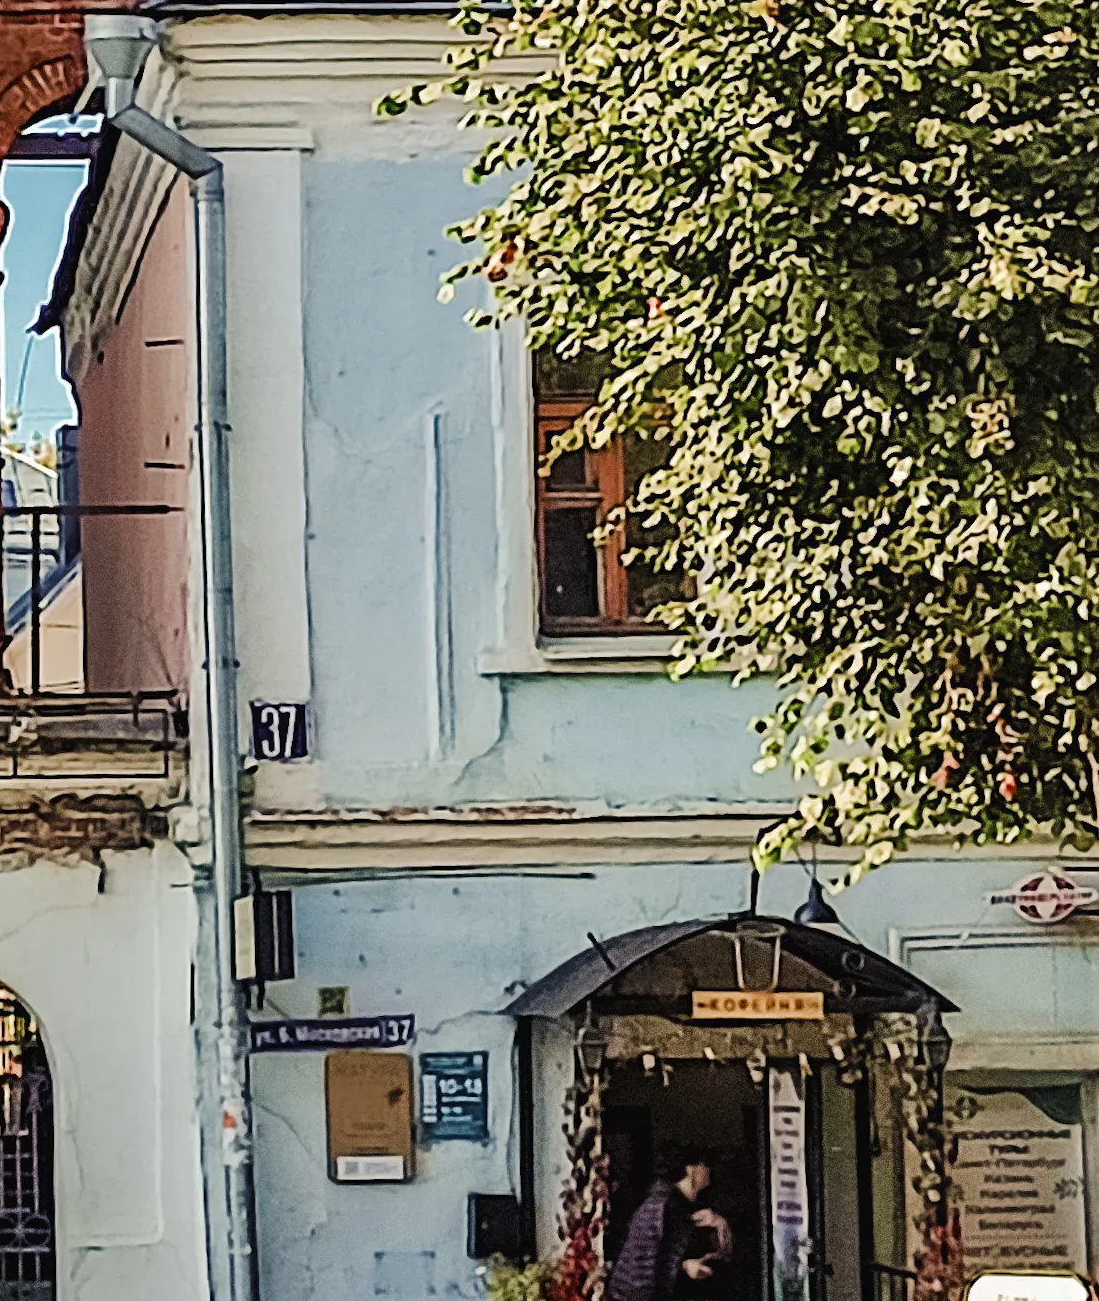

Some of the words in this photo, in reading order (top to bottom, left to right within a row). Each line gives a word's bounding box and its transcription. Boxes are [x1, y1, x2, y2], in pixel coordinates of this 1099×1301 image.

[261, 706, 297, 758] 37
[710, 998, 805, 1013] КОФЕЙНЯ
[388, 1019, 411, 1042] 37
